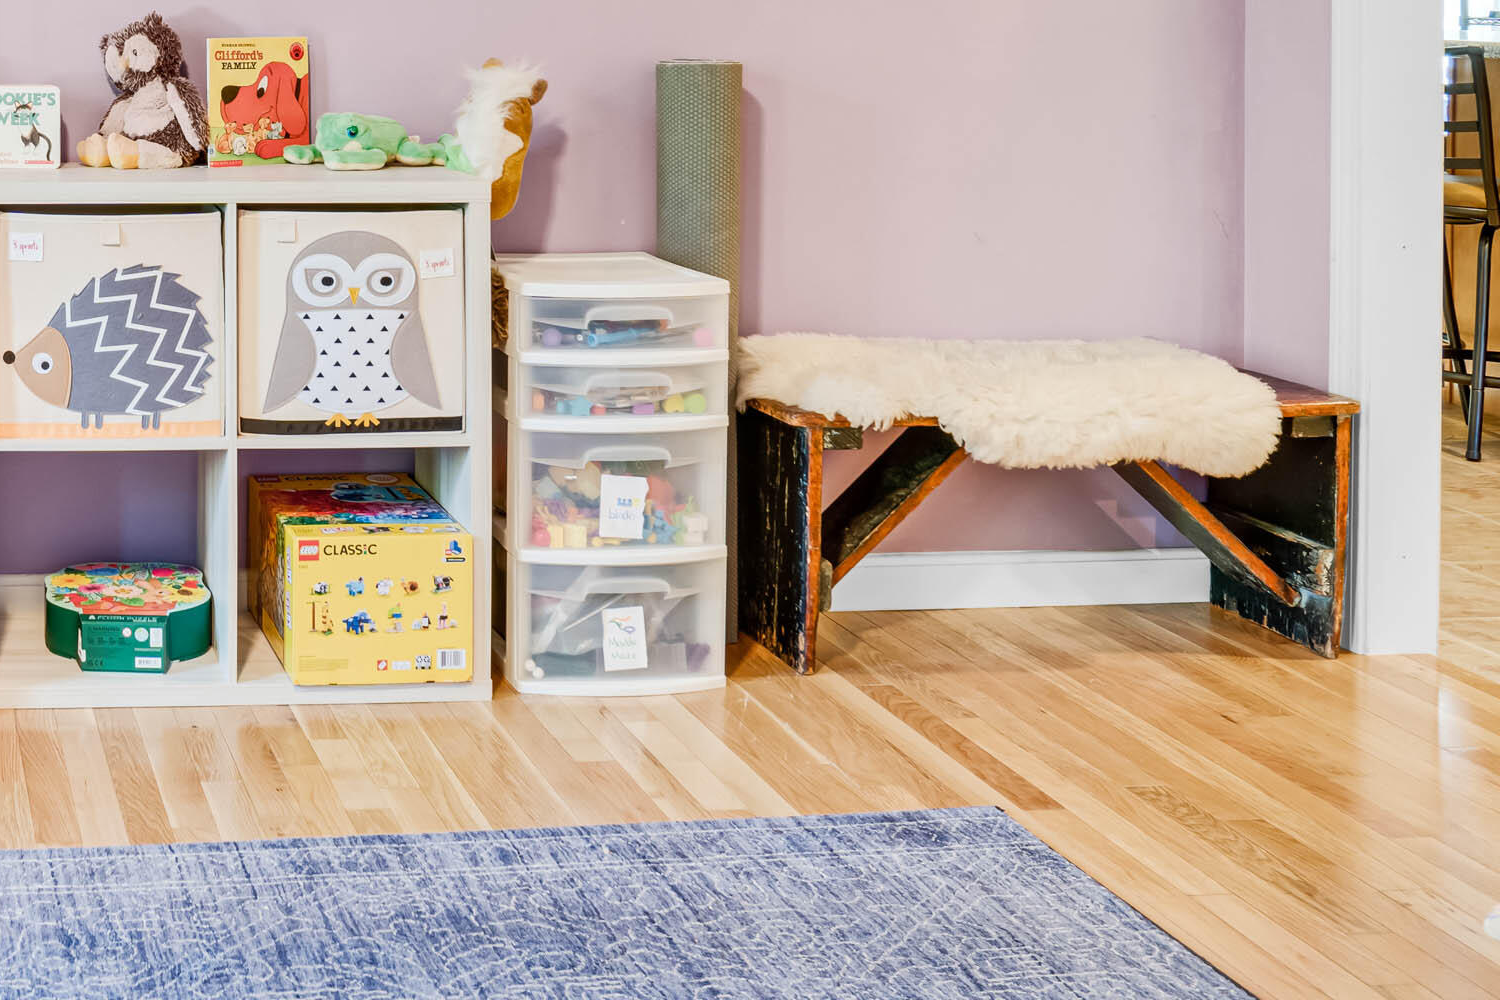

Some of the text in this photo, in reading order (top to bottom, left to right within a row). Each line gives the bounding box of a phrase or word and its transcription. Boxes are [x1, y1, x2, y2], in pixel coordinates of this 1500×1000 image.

[214, 50, 264, 61] Clifford's
[221, 62, 257, 70] FAMILY
[323, 543, 378, 556] CLASSIC
